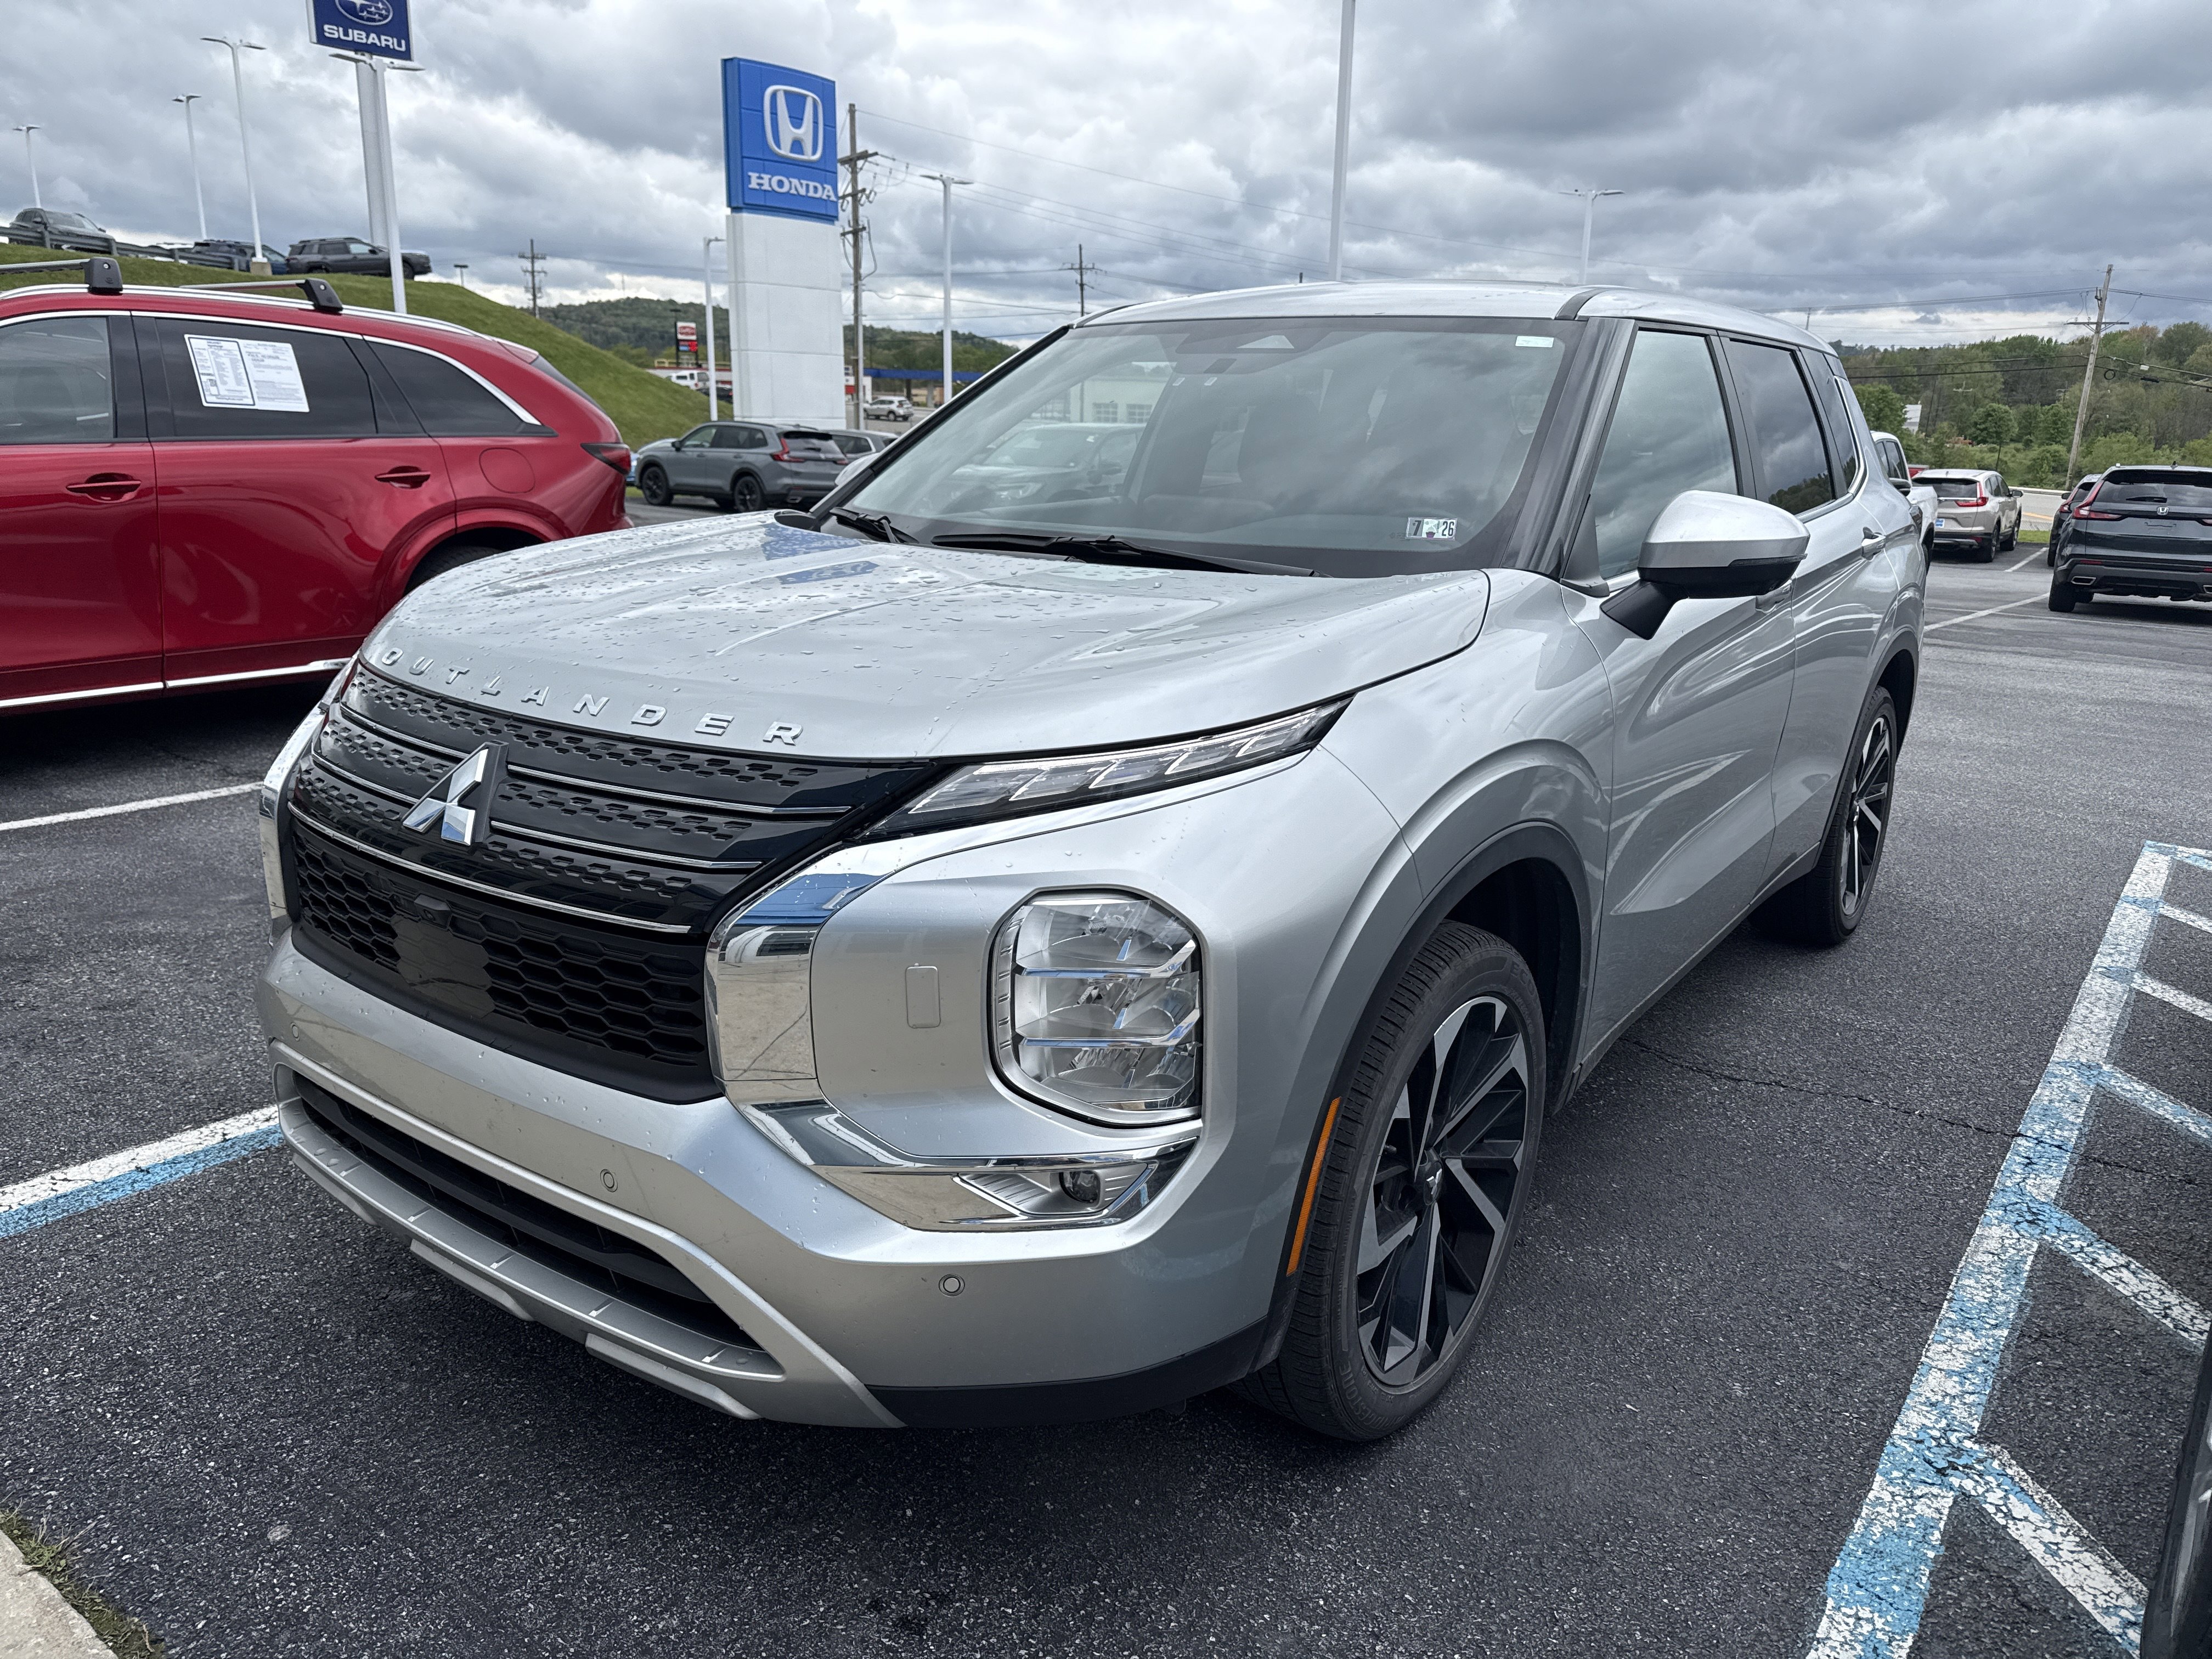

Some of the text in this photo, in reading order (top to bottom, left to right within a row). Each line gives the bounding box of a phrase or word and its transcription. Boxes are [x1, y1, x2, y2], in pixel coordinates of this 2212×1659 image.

[323, 24, 406, 52] SUBARU
[747, 172, 837, 202] HONDA
[1413, 520, 1421, 536] 7
[1442, 521, 1454, 537] 26
[381, 647, 804, 746] OUTLANDER
